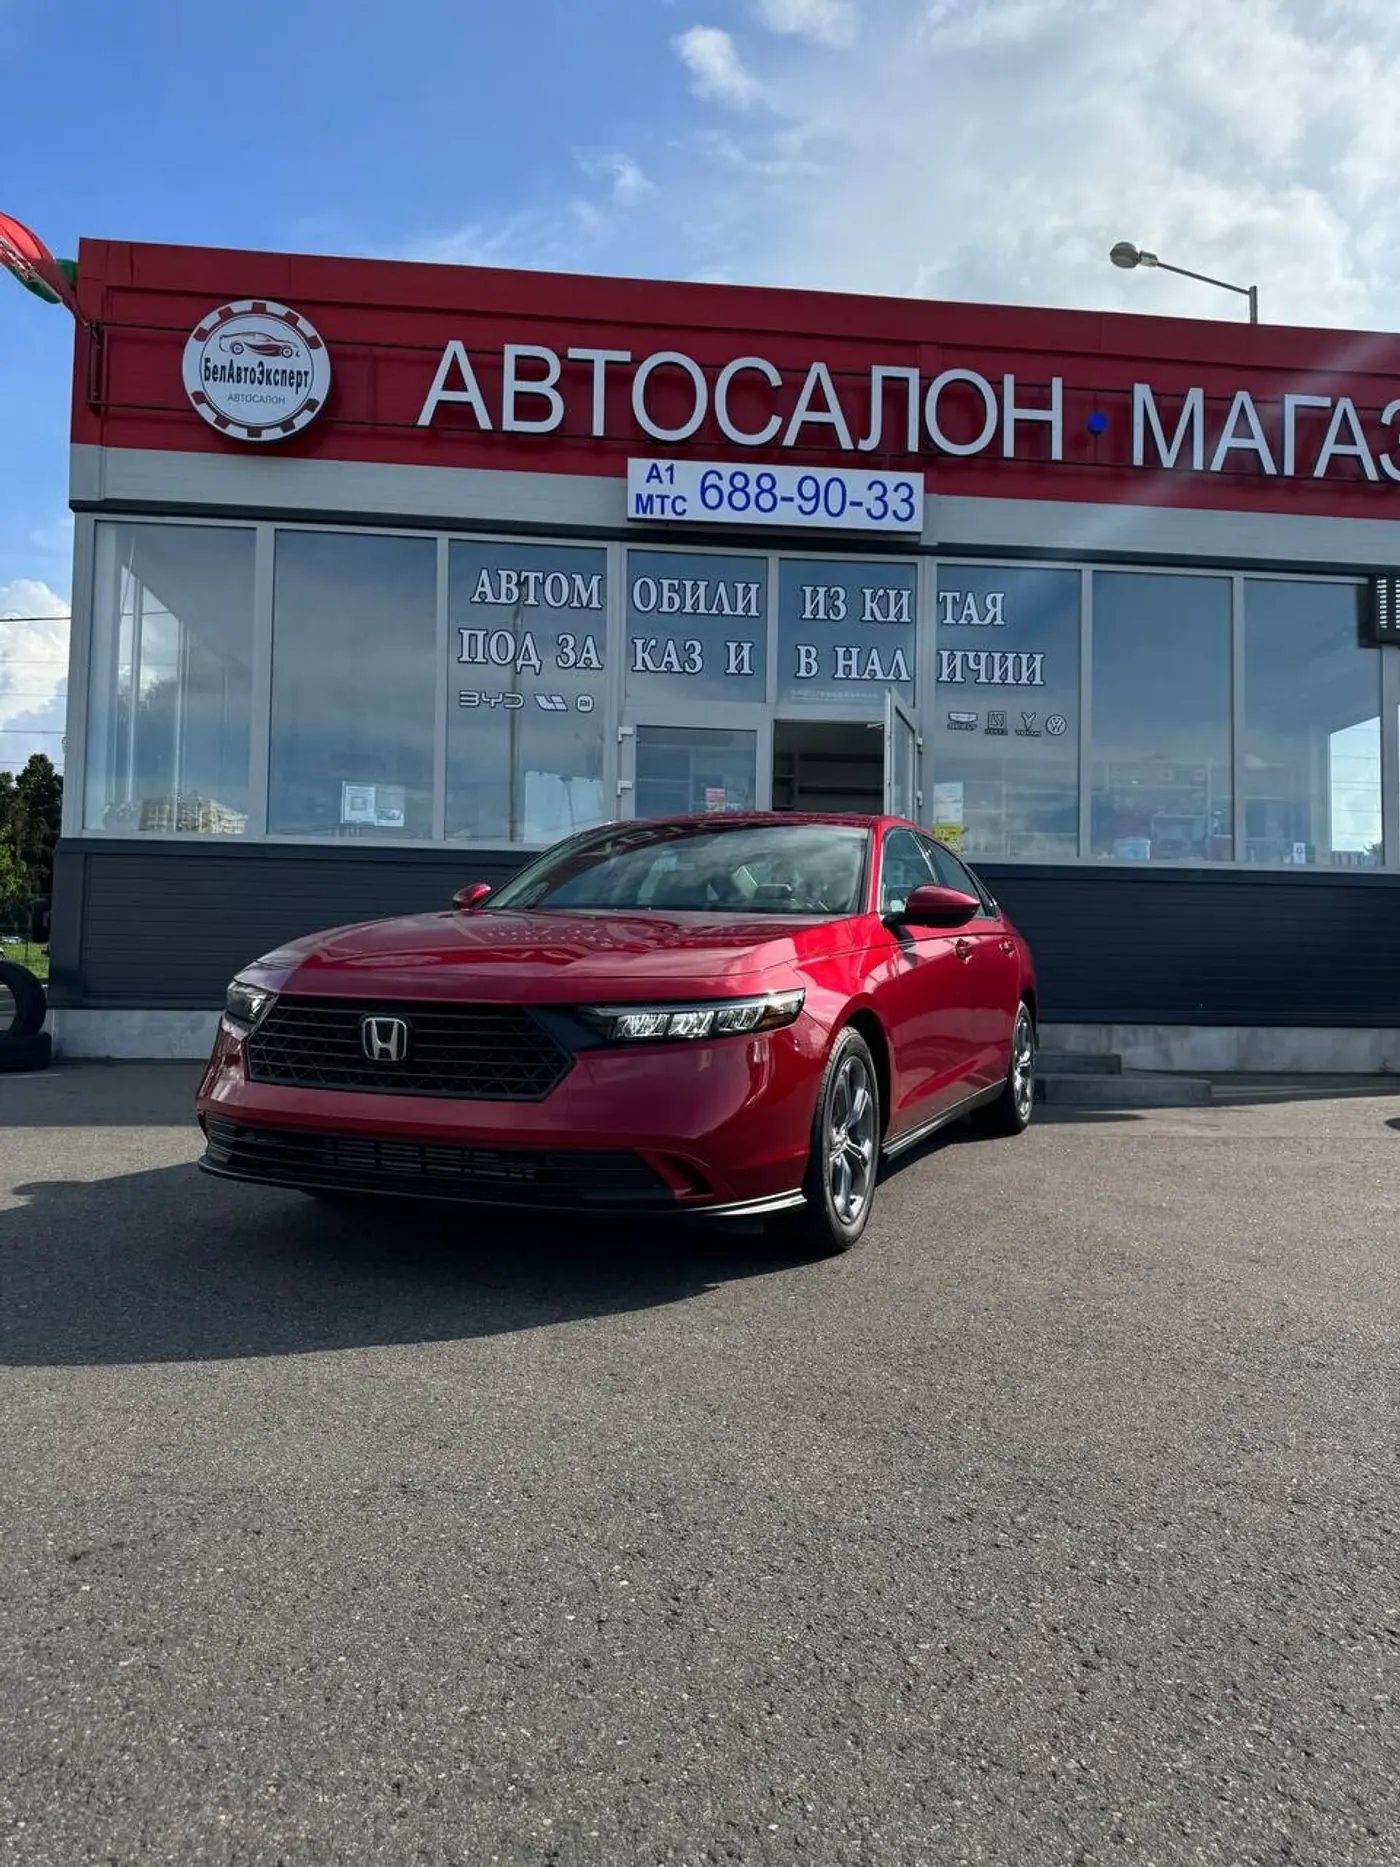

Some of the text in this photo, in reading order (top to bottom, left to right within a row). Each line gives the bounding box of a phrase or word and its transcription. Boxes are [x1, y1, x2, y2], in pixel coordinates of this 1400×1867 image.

[203, 357, 310, 394] БелАвтоЭксперт
[227, 393, 286, 405] АВТОСАЛОН
[416, 339, 1063, 460] АВТОСАЛОН
[635, 493, 688, 516] МТС
[700, 469, 916, 523] 688-90-33
[800, 585, 848, 621] ИЗ
[457, 628, 543, 676] ПОД
[725, 641, 755, 675] И
[795, 644, 820, 679] В
[458, 690, 526, 710] BYD
